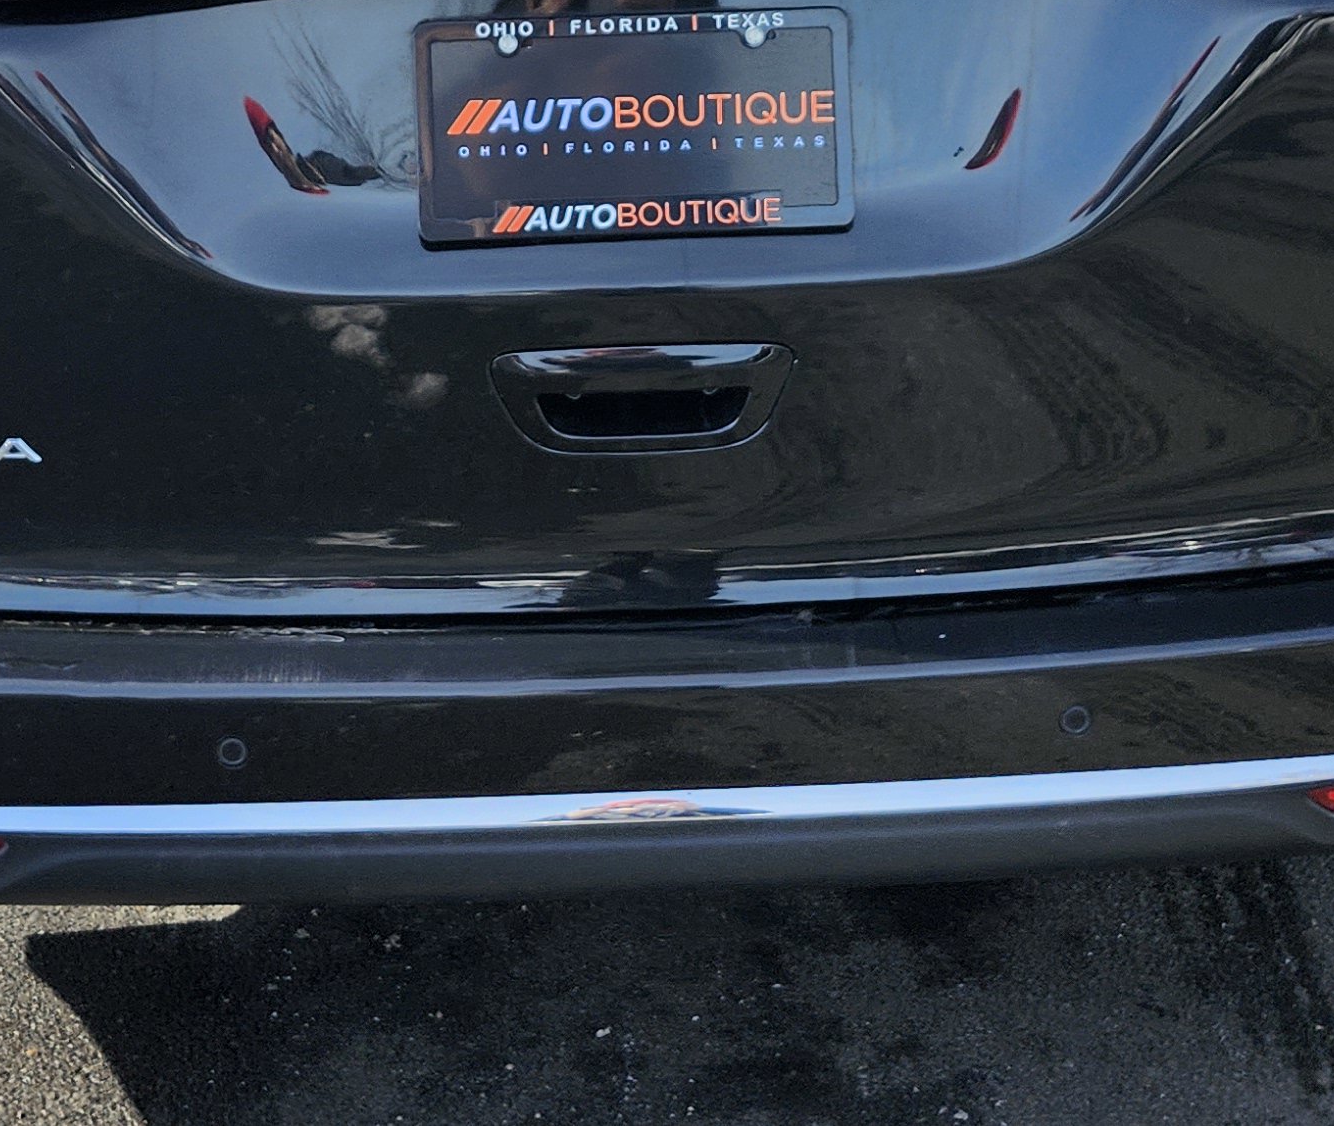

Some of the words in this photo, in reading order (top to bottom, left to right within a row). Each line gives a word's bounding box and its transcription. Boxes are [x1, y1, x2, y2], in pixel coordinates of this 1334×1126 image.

[475, 20, 534, 38] OHIO
[569, 16, 679, 35] FLORIDA
[712, 12, 785, 30] TEXAS
[488, 89, 835, 134] AUTOBOUTIQUE
[458, 143, 528, 158] OHIO
[565, 139, 692, 155] FLORIDA
[734, 134, 827, 149] TEXAS
[524, 196, 782, 231] AUTOBOUTIQUE
